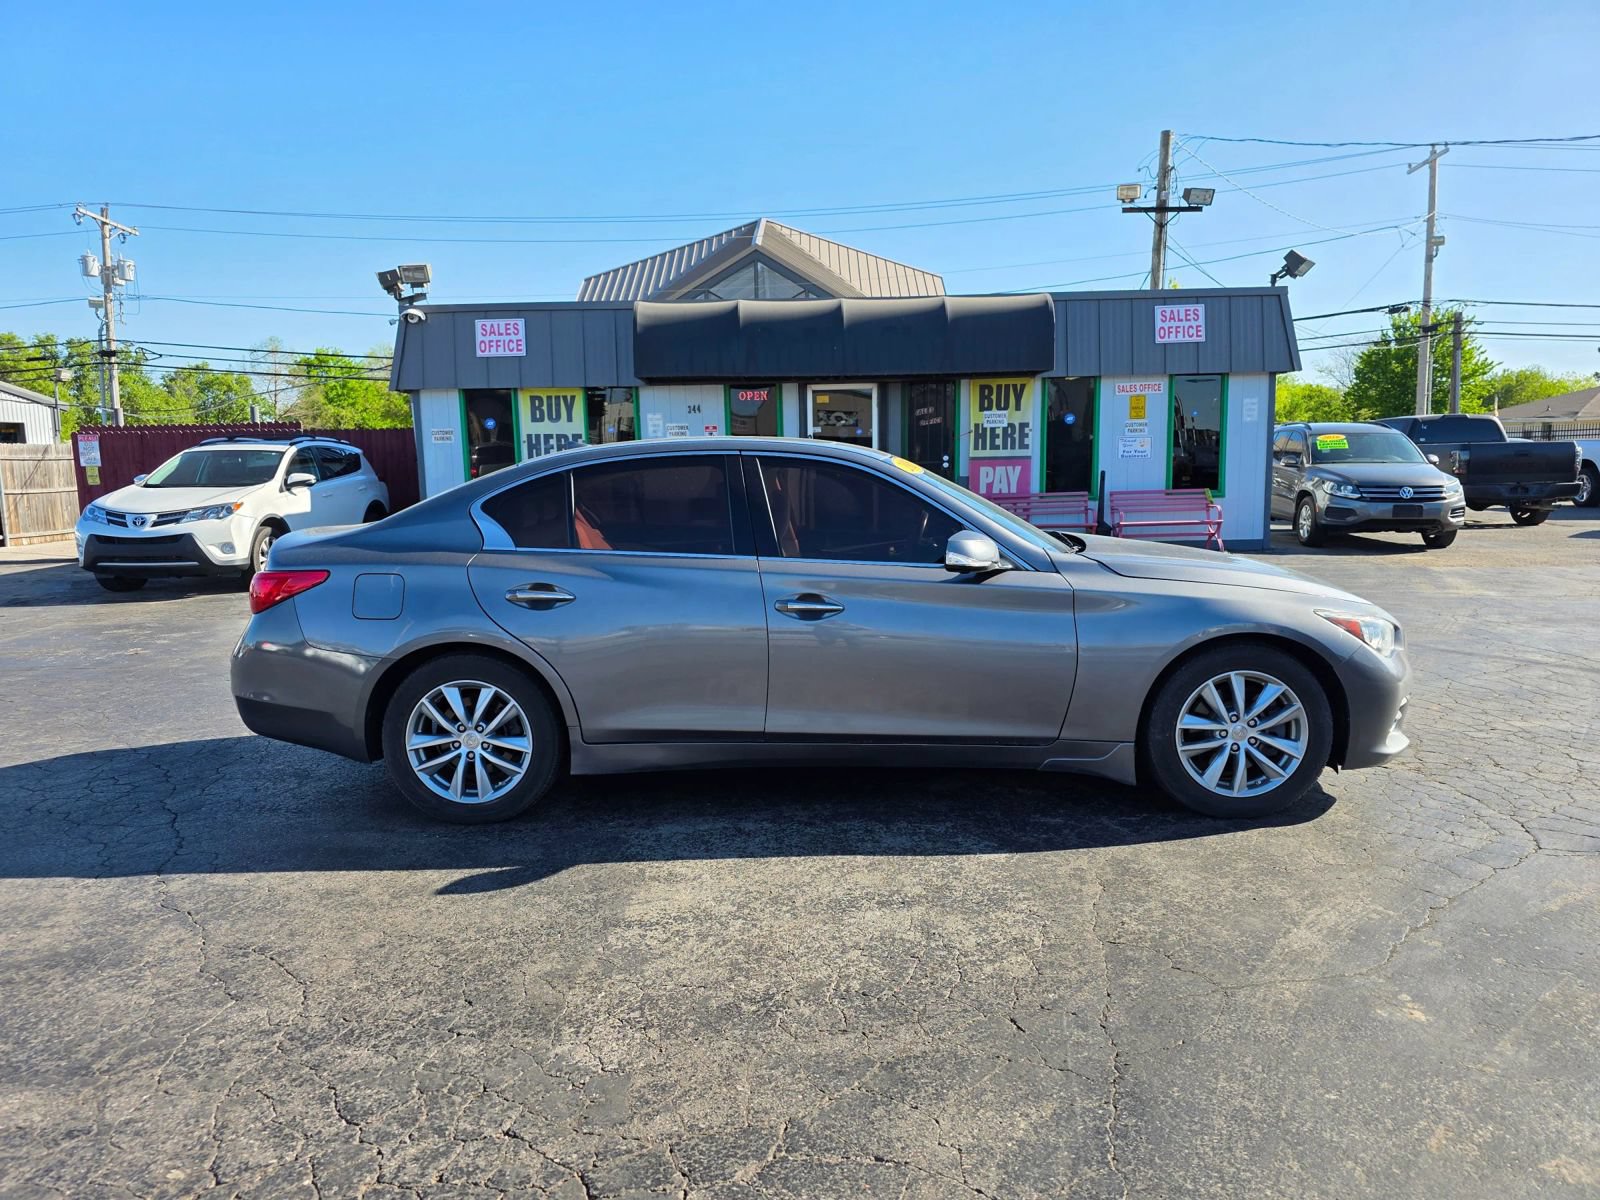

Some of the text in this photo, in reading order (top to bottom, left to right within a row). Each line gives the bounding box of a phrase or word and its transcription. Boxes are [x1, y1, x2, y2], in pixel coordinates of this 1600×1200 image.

[1160, 308, 1200, 323] SALES
[481, 323, 520, 337] SALES
[1158, 325, 1202, 340] OFFICE
[479, 339, 523, 353] OFFICE
[738, 391, 768, 401] OPEN
[1117, 383, 1162, 394] SALES OFFICE
[979, 383, 1027, 412] BUY
[529, 395, 576, 423] BUY
[974, 422, 1030, 451] HERE
[979, 466, 1022, 494] PAY
